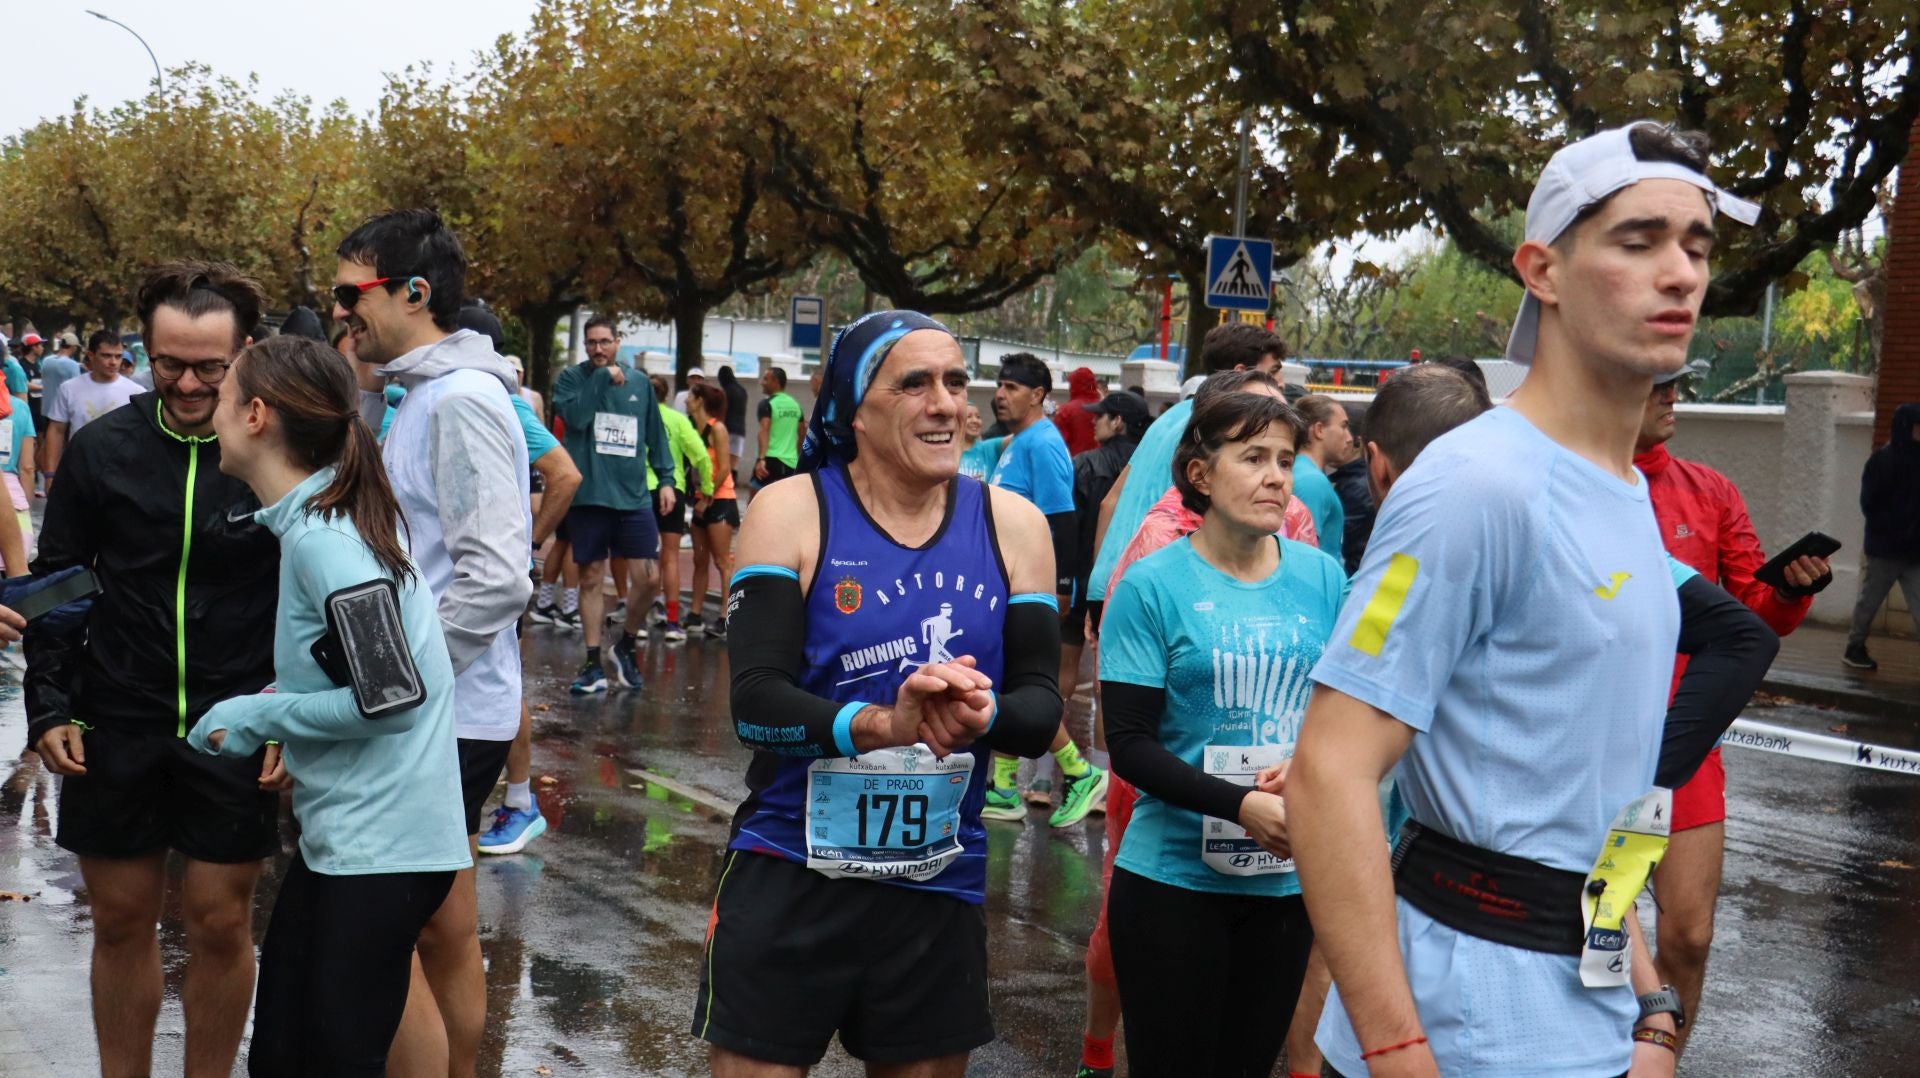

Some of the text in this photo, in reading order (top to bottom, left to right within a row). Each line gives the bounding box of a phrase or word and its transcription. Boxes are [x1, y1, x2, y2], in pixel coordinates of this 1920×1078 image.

[604, 427, 627, 444] 794
[876, 571, 998, 612] ASTORGA
[840, 636, 918, 672] RUNNING
[780, 725, 806, 742] CROSS
[1722, 729, 1792, 752] utxabank
[849, 763, 887, 771] kutxabank
[864, 778, 924, 790] DE PRADO
[856, 793, 929, 847] 179
[872, 857, 943, 876] HYUNDAI
